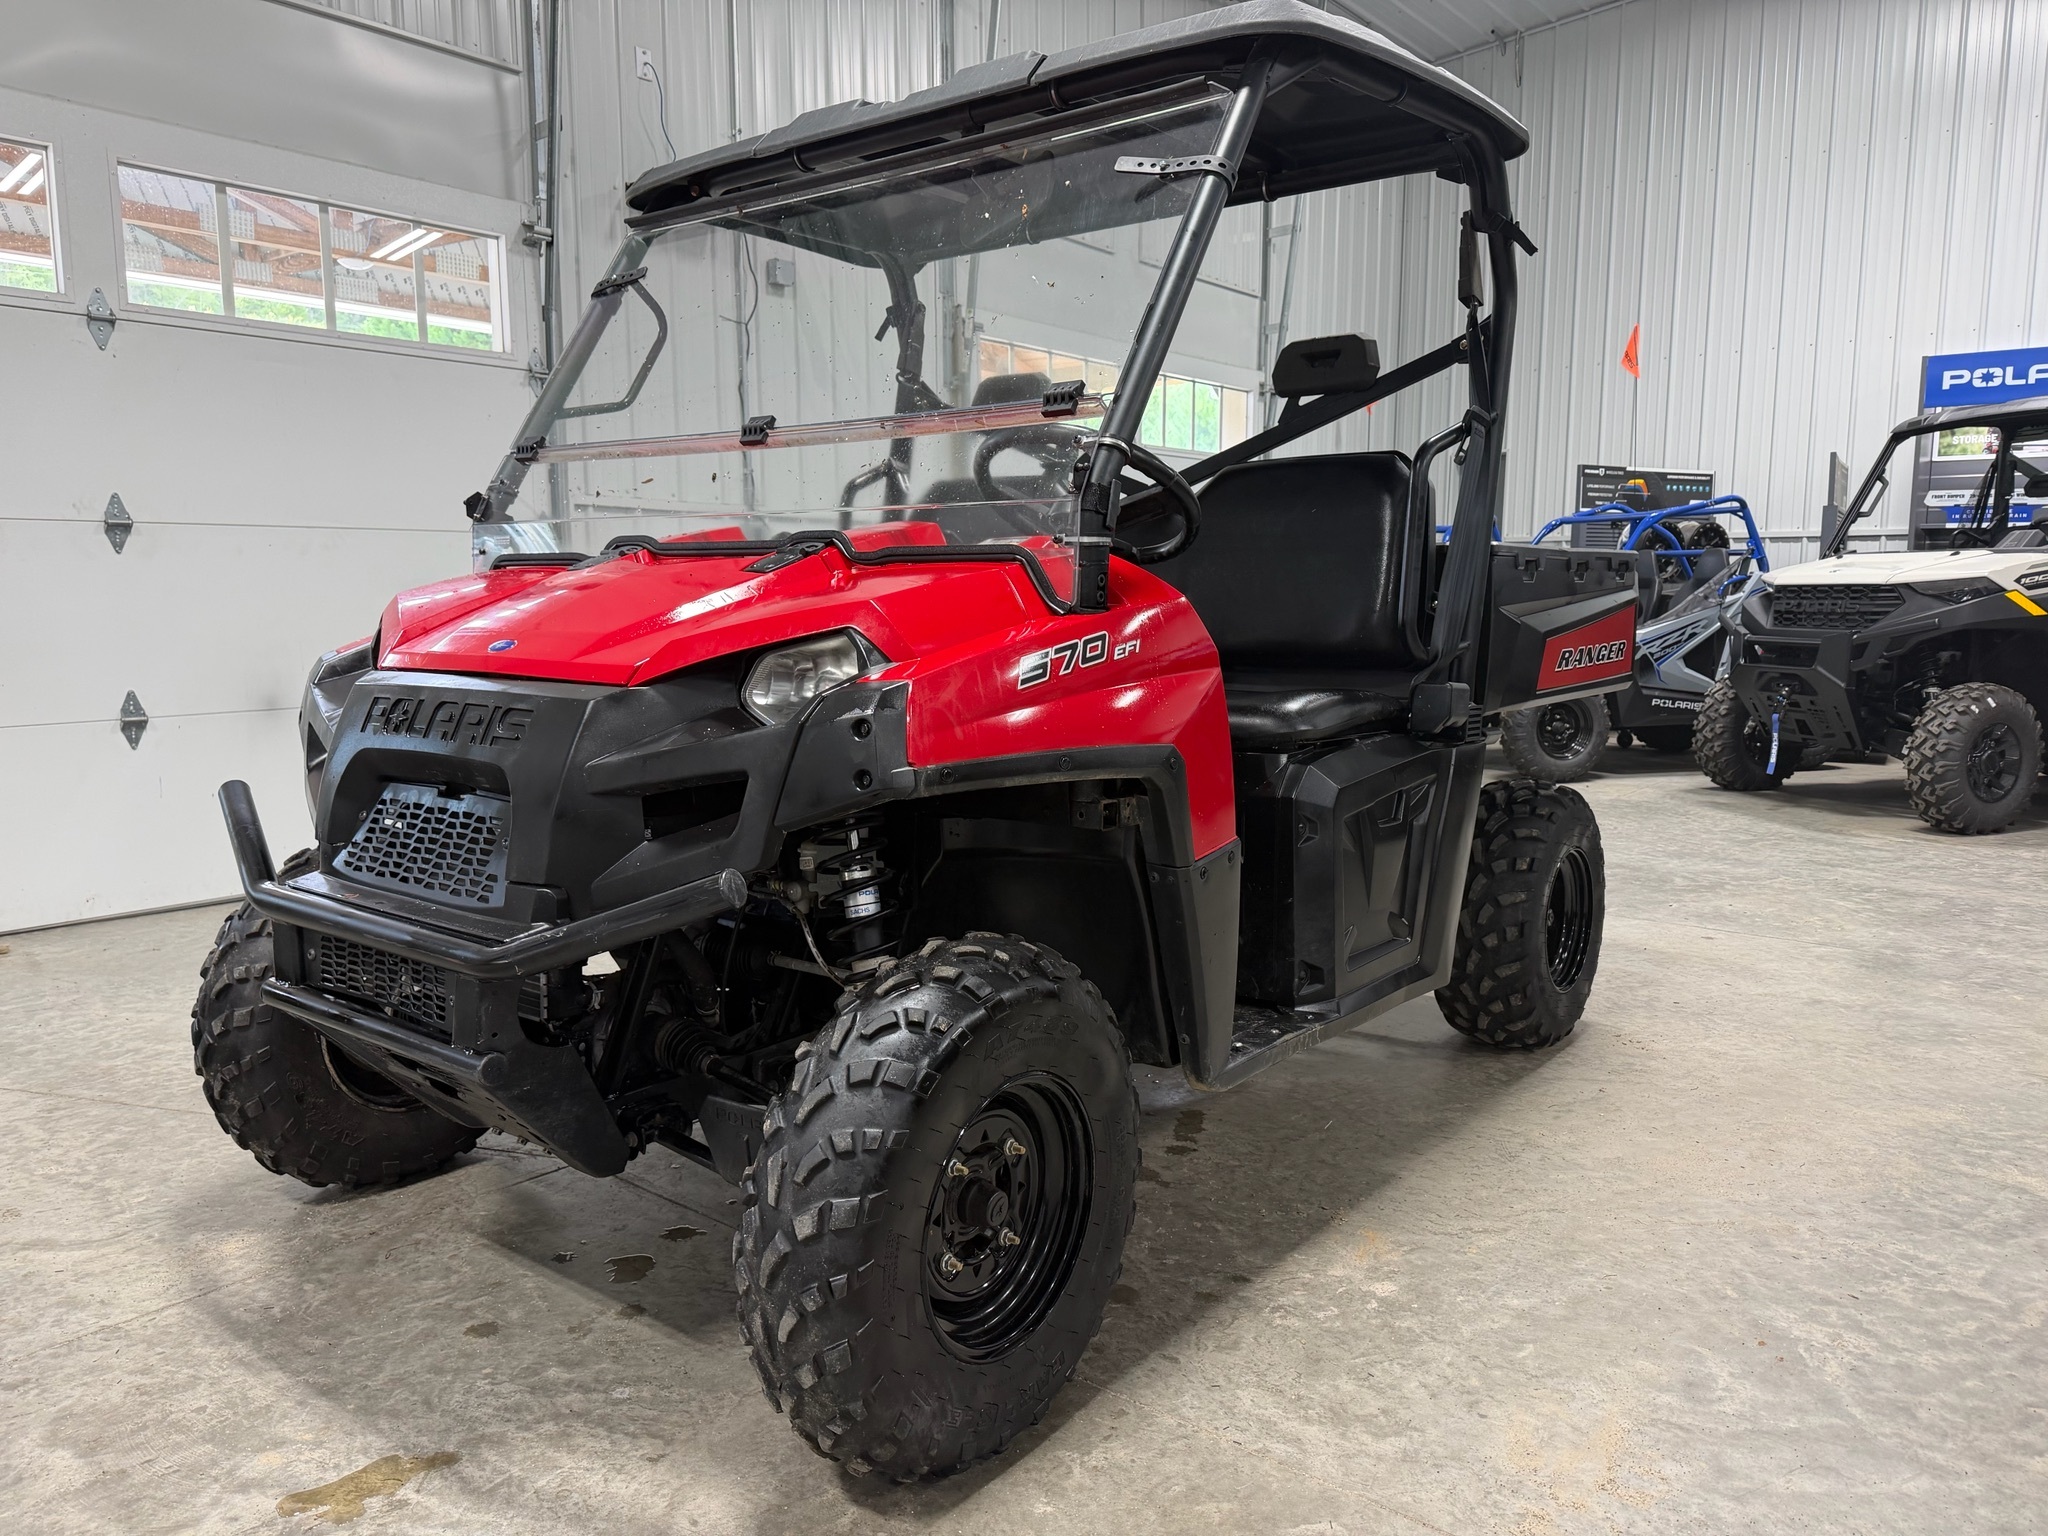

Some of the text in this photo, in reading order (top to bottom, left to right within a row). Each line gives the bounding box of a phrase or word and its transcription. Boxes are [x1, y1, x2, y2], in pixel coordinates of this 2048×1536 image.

[1952, 433, 1998, 445] STORAGE
[1782, 599, 1860, 612] POLARIS
[1635, 619, 1708, 660] RZR
[1017, 631, 1140, 690] 570 EFI
[1554, 640, 1627, 671] RANGER
[1651, 698, 1703, 710] POLARIS
[360, 696, 535, 747] POLARIS
[850, 907, 871, 916] SACHS
